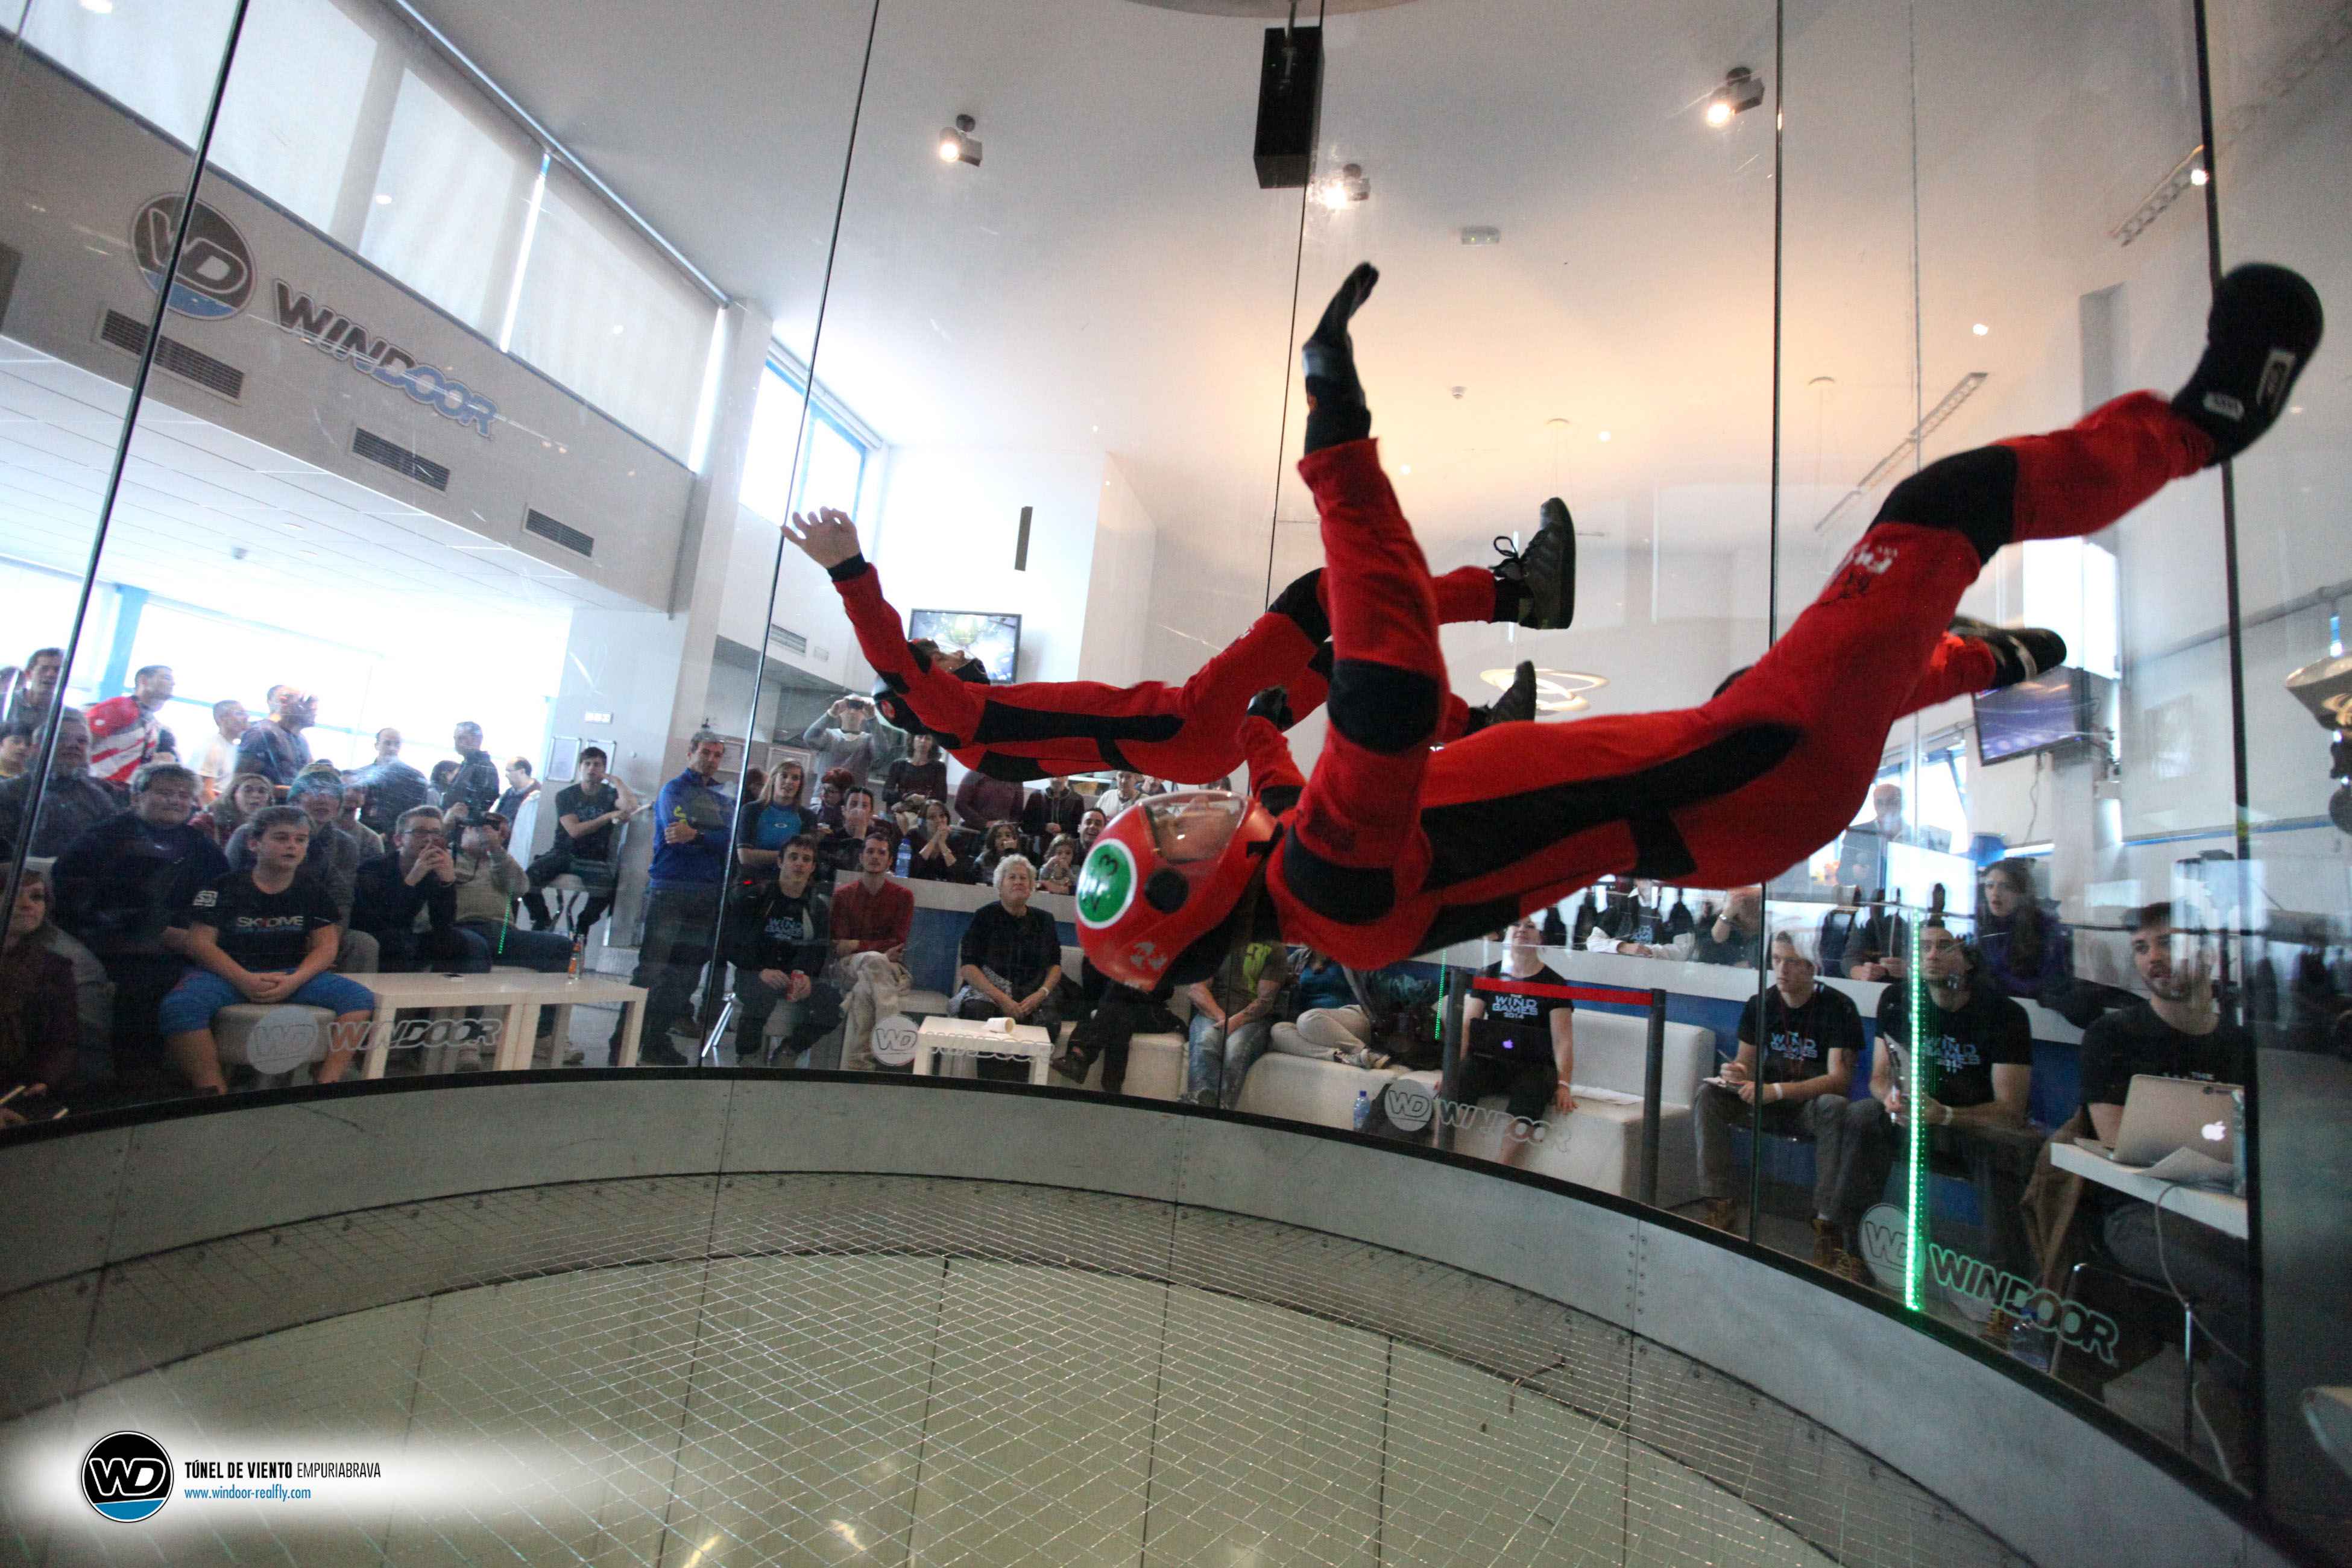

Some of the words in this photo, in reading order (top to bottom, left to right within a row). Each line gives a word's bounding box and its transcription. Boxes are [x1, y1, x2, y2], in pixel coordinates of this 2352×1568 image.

[273, 279, 500, 438] WINDOOR
[1492, 1003, 1538, 1016] GAMES
[1495, 995, 1537, 1008] WIND
[328, 1019, 502, 1053] WINDOOR
[876, 1028, 918, 1051] WD
[1388, 1090, 1431, 1118] WD
[1438, 1099, 1568, 1150] WINDOO
[1929, 1243, 2119, 1365] WINDOOR
